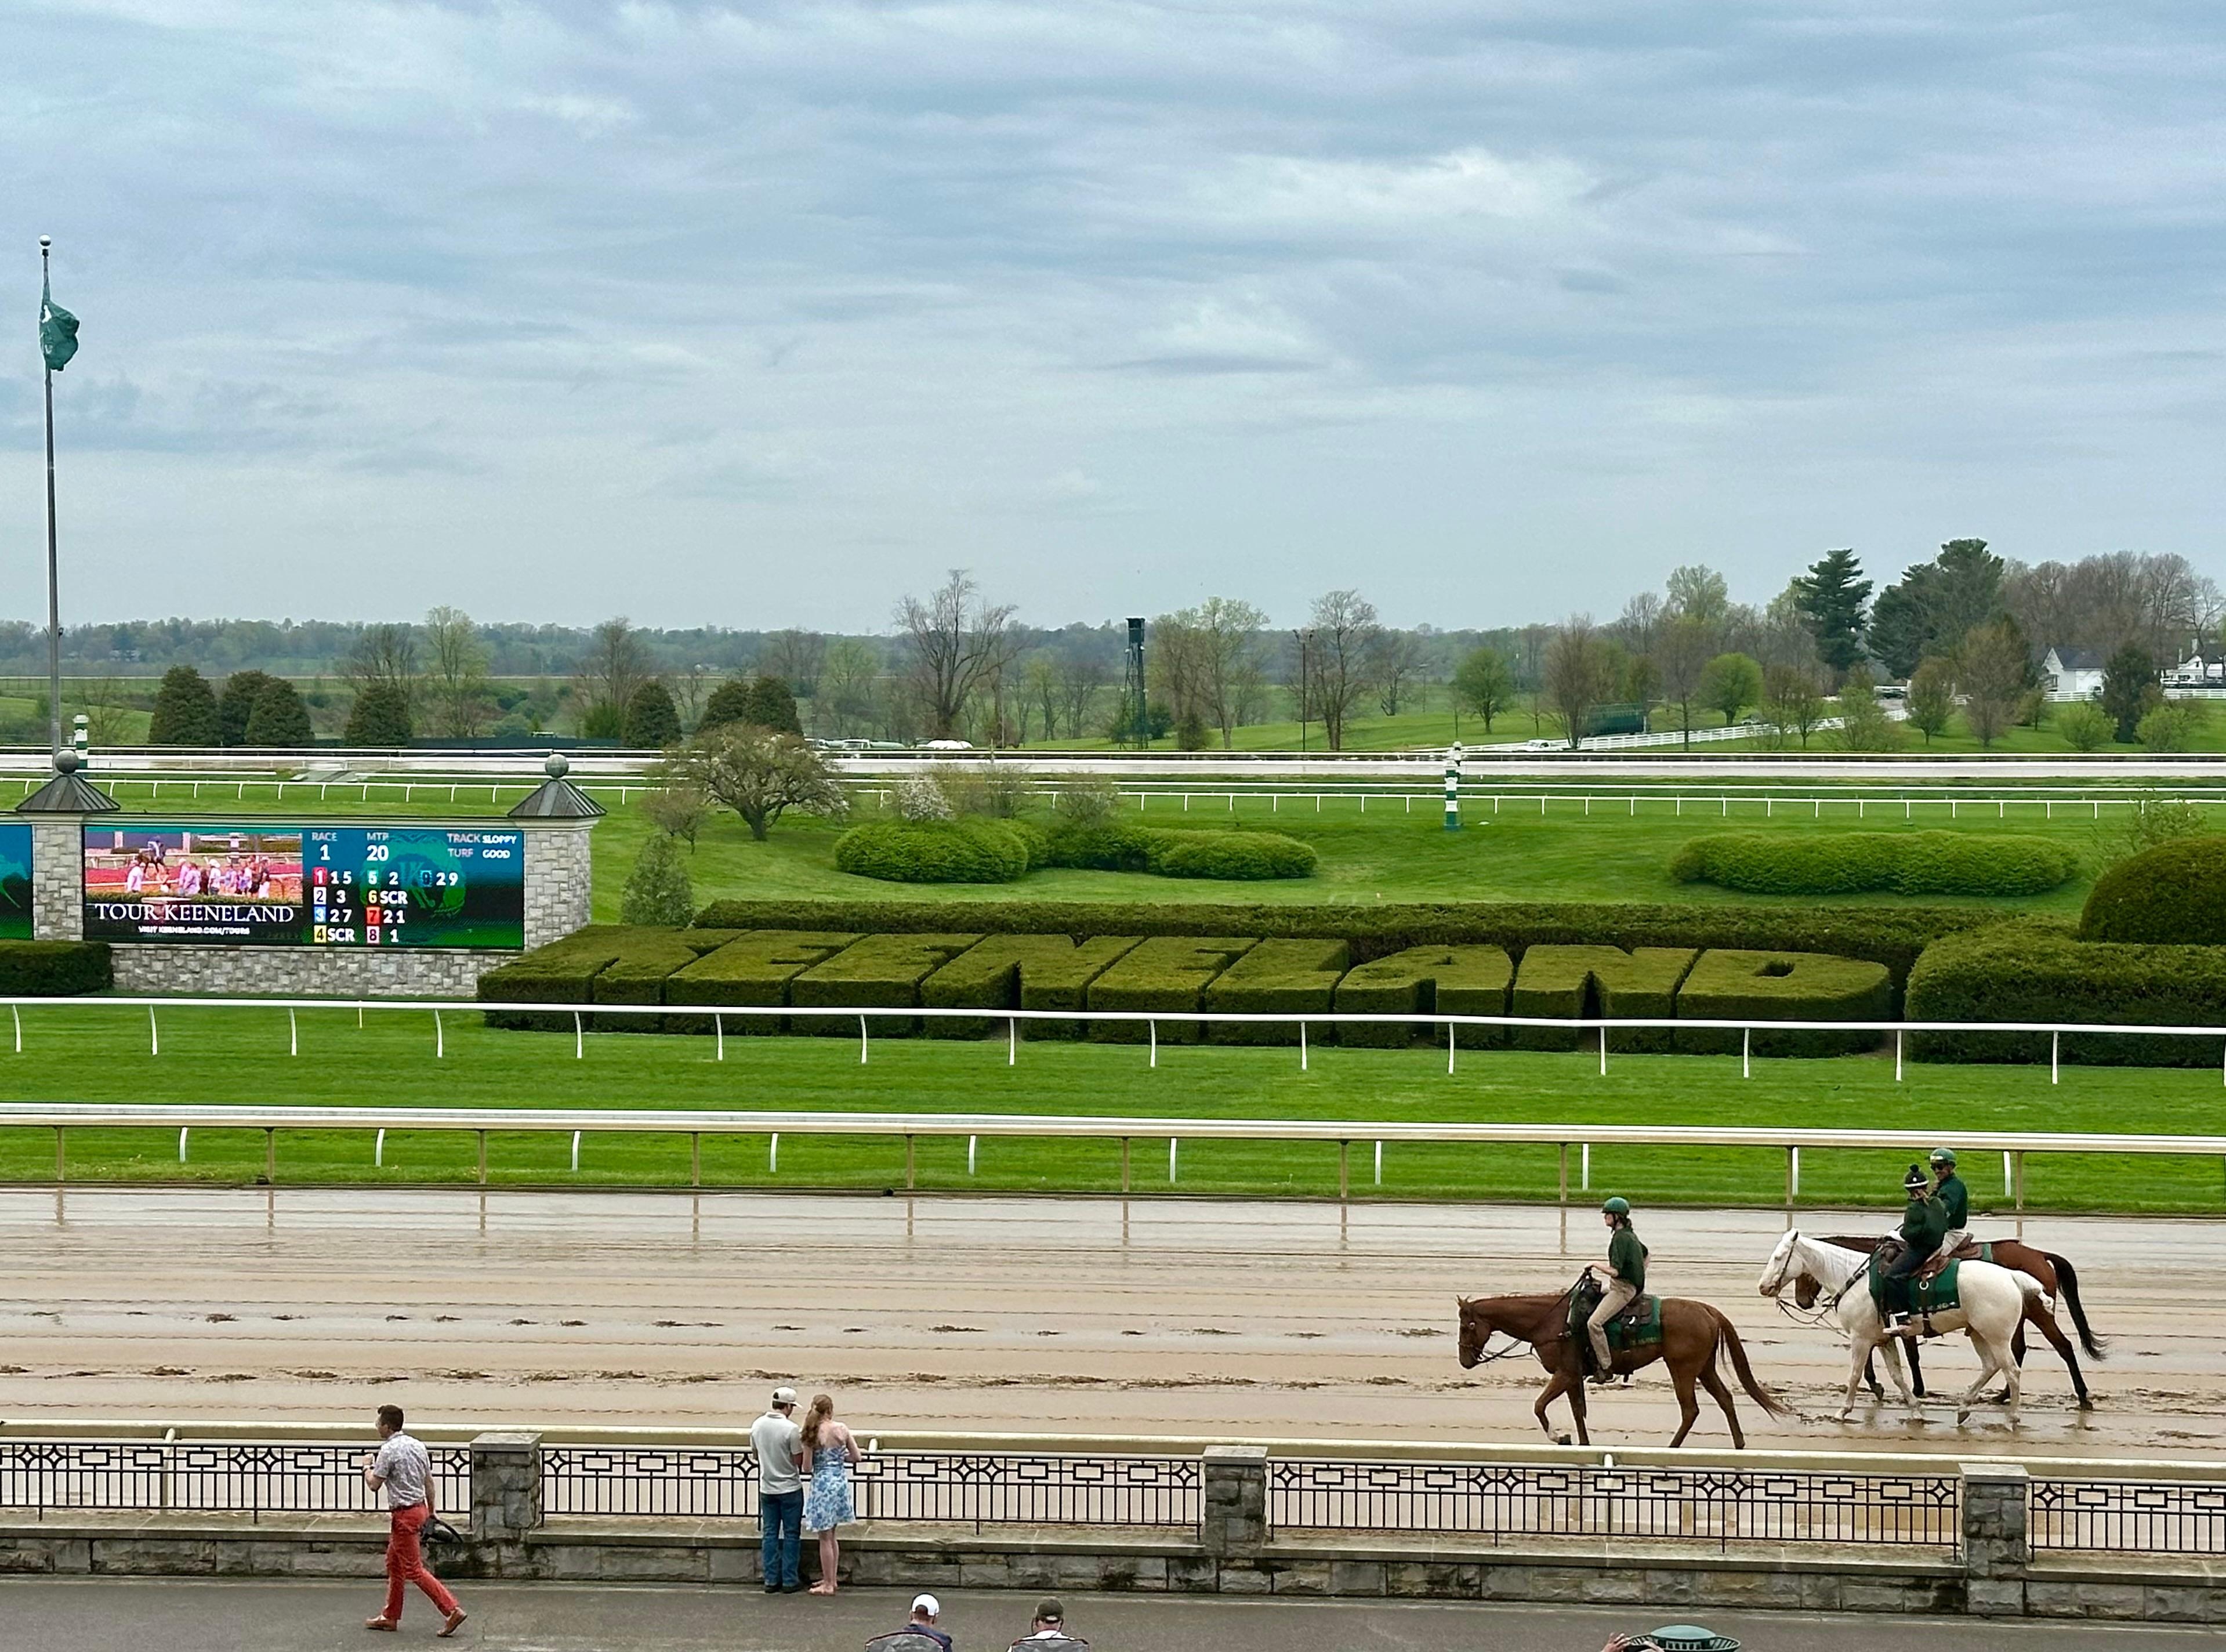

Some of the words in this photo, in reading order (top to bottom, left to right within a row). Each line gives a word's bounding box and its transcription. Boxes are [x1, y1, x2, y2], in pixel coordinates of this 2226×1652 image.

[311, 832, 338, 841] RACE
[367, 832, 389, 841] MTP
[447, 833, 481, 843] TRACK
[482, 835, 517, 845] SLOPPY
[320, 844, 331, 861] 1
[367, 845, 389, 861] 20
[447, 848, 474, 858] TURF
[482, 849, 511, 858] GOOD
[314, 870, 324, 885] 1
[368, 871, 378, 885] 5
[389, 871, 399, 885] 2
[316, 890, 324, 903] 2
[336, 890, 346, 904] 3
[368, 890, 378, 904] 6
[379, 890, 408, 905] SCR
[94, 903, 160, 921] TOUR
[164, 904, 294, 922] KEENELAND
[315, 908, 324, 922] 3
[369, 910, 378, 922] 7
[316, 928, 324, 940] 4
[327, 928, 356, 942] SCR
[369, 929, 377, 941] 8
[389, 929, 399, 943] 1
